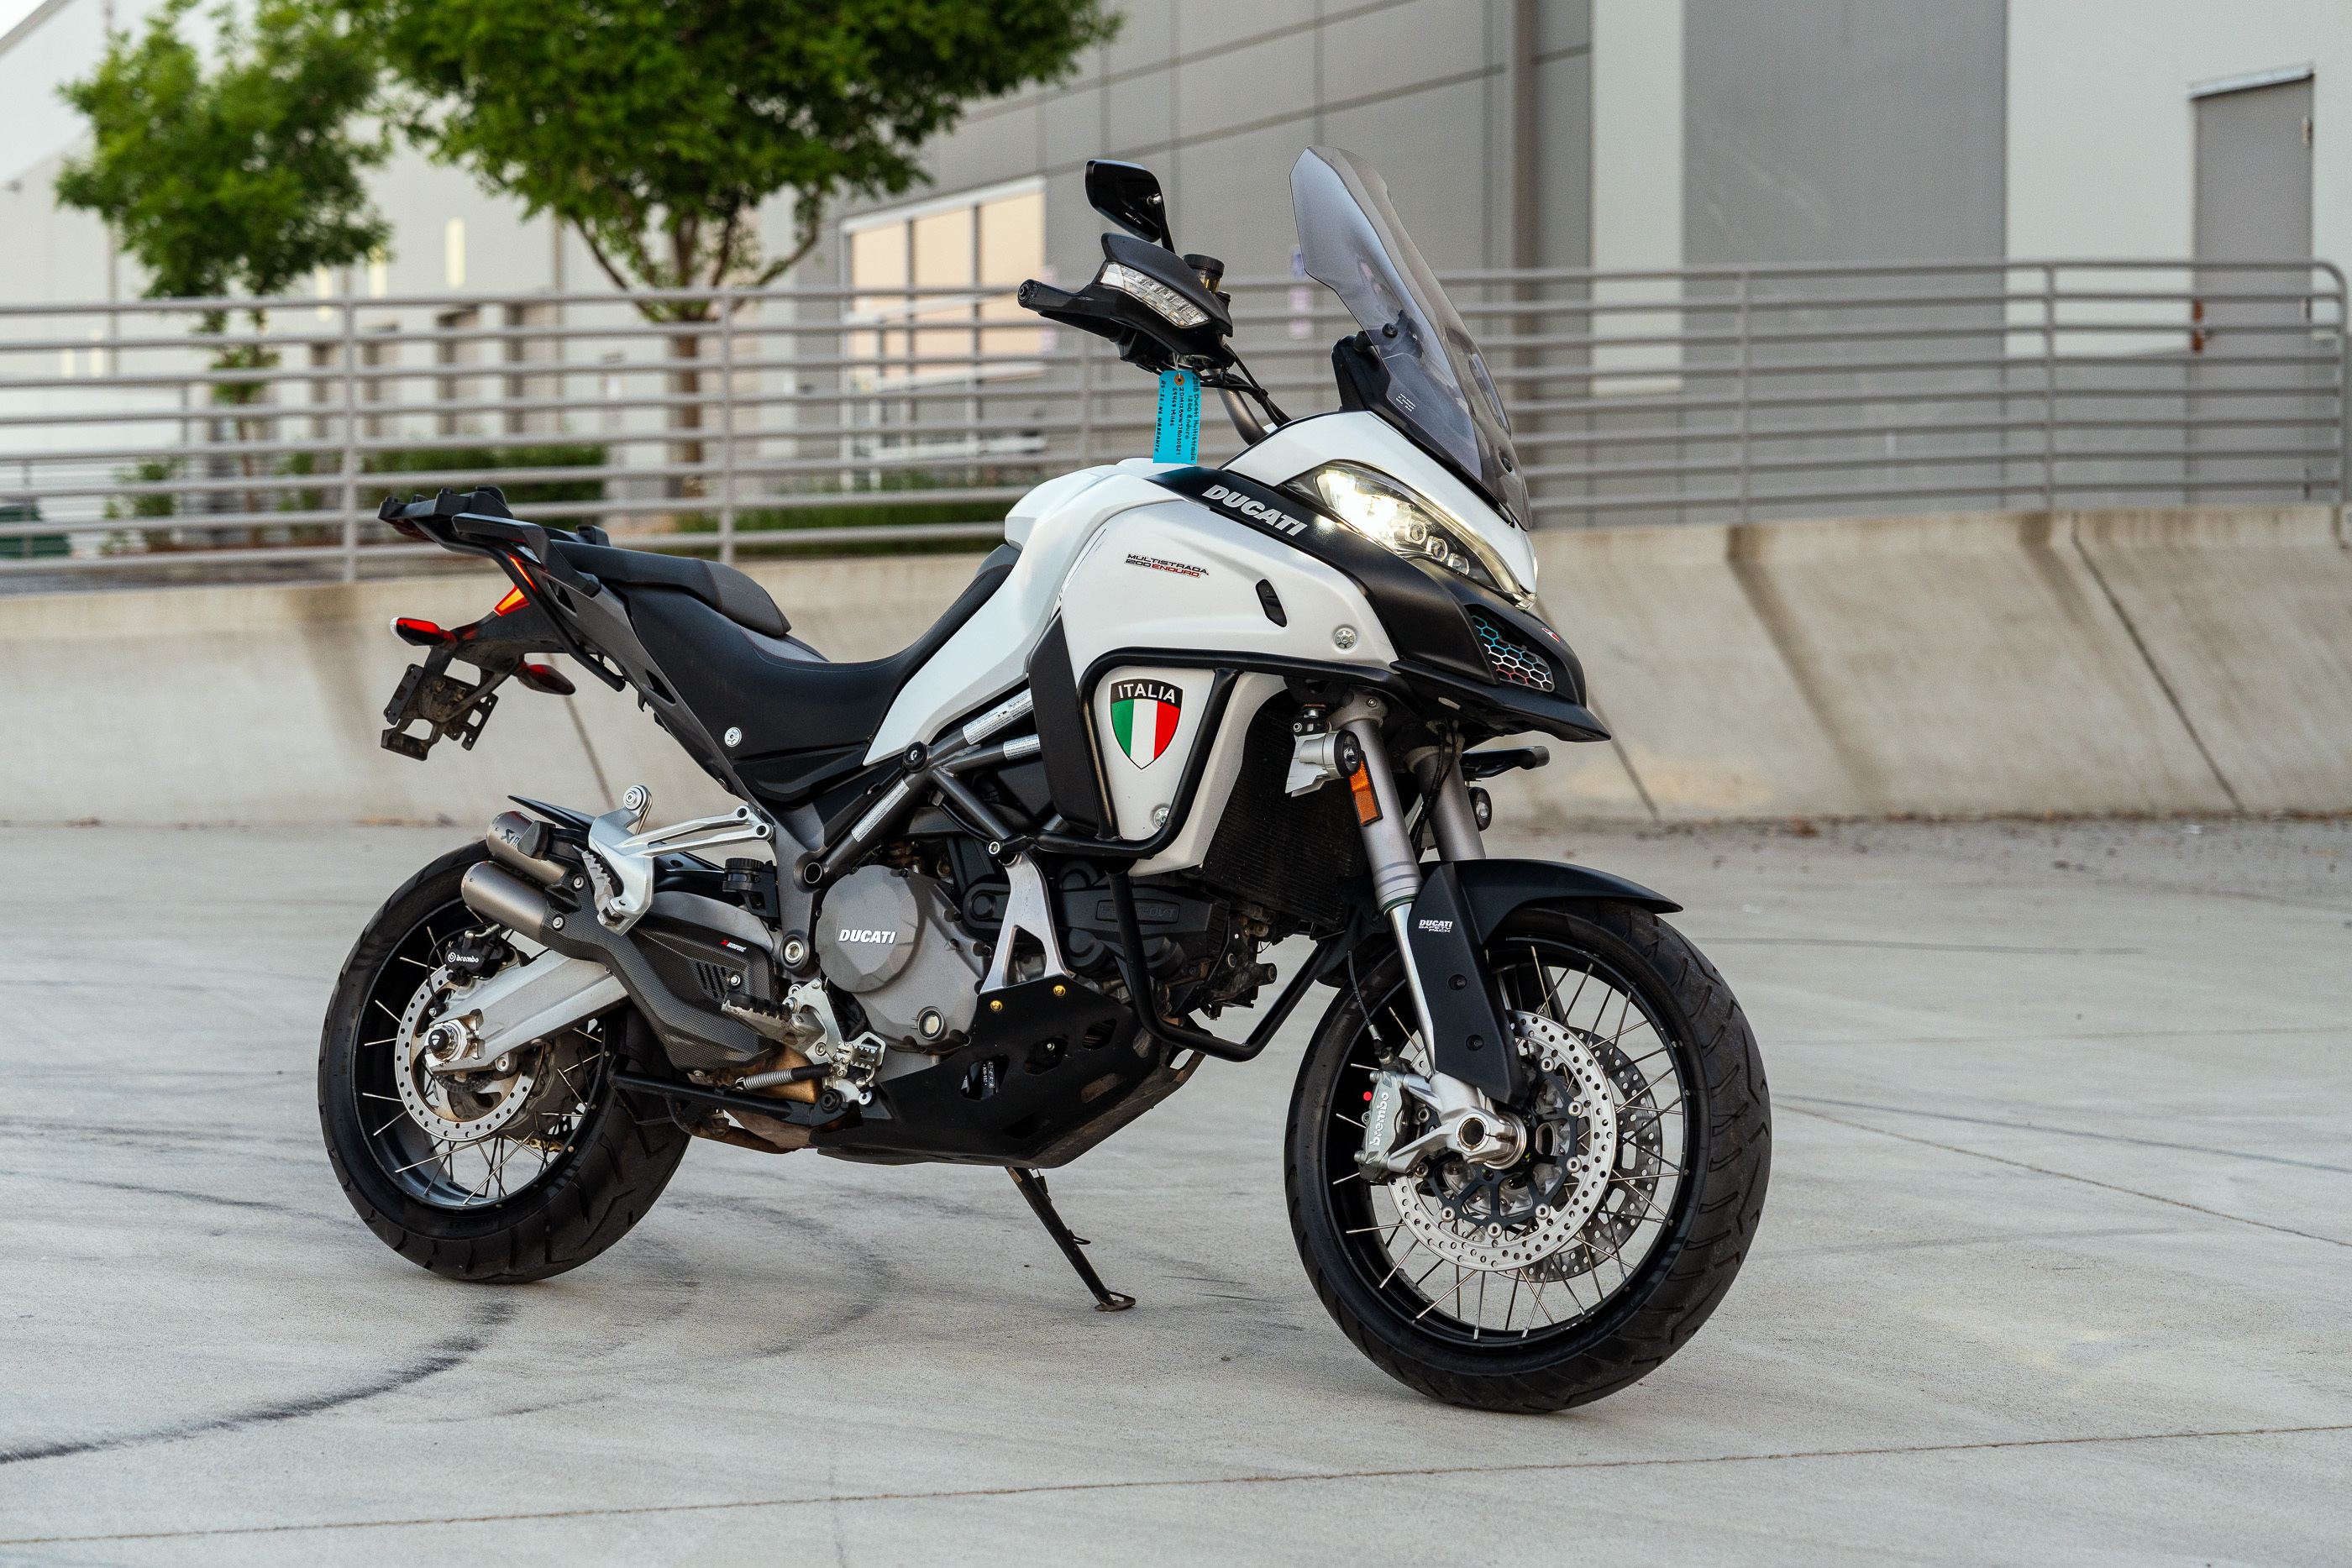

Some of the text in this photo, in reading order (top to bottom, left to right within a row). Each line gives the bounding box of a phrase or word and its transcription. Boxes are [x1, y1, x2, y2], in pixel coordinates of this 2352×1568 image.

[1190, 420, 1199, 460] Multistrada
[1202, 485, 1308, 536] DUCATI
[1126, 559, 1200, 577] 1200 ENDURO
[1127, 553, 1206, 574] MULTISTRADA
[1118, 684, 1175, 703] ITALIA
[1419, 920, 1453, 928] DUCATI
[838, 929, 896, 944] DUCATI
[456, 954, 480, 963] brembo
[1369, 1092, 1389, 1146] brembo
